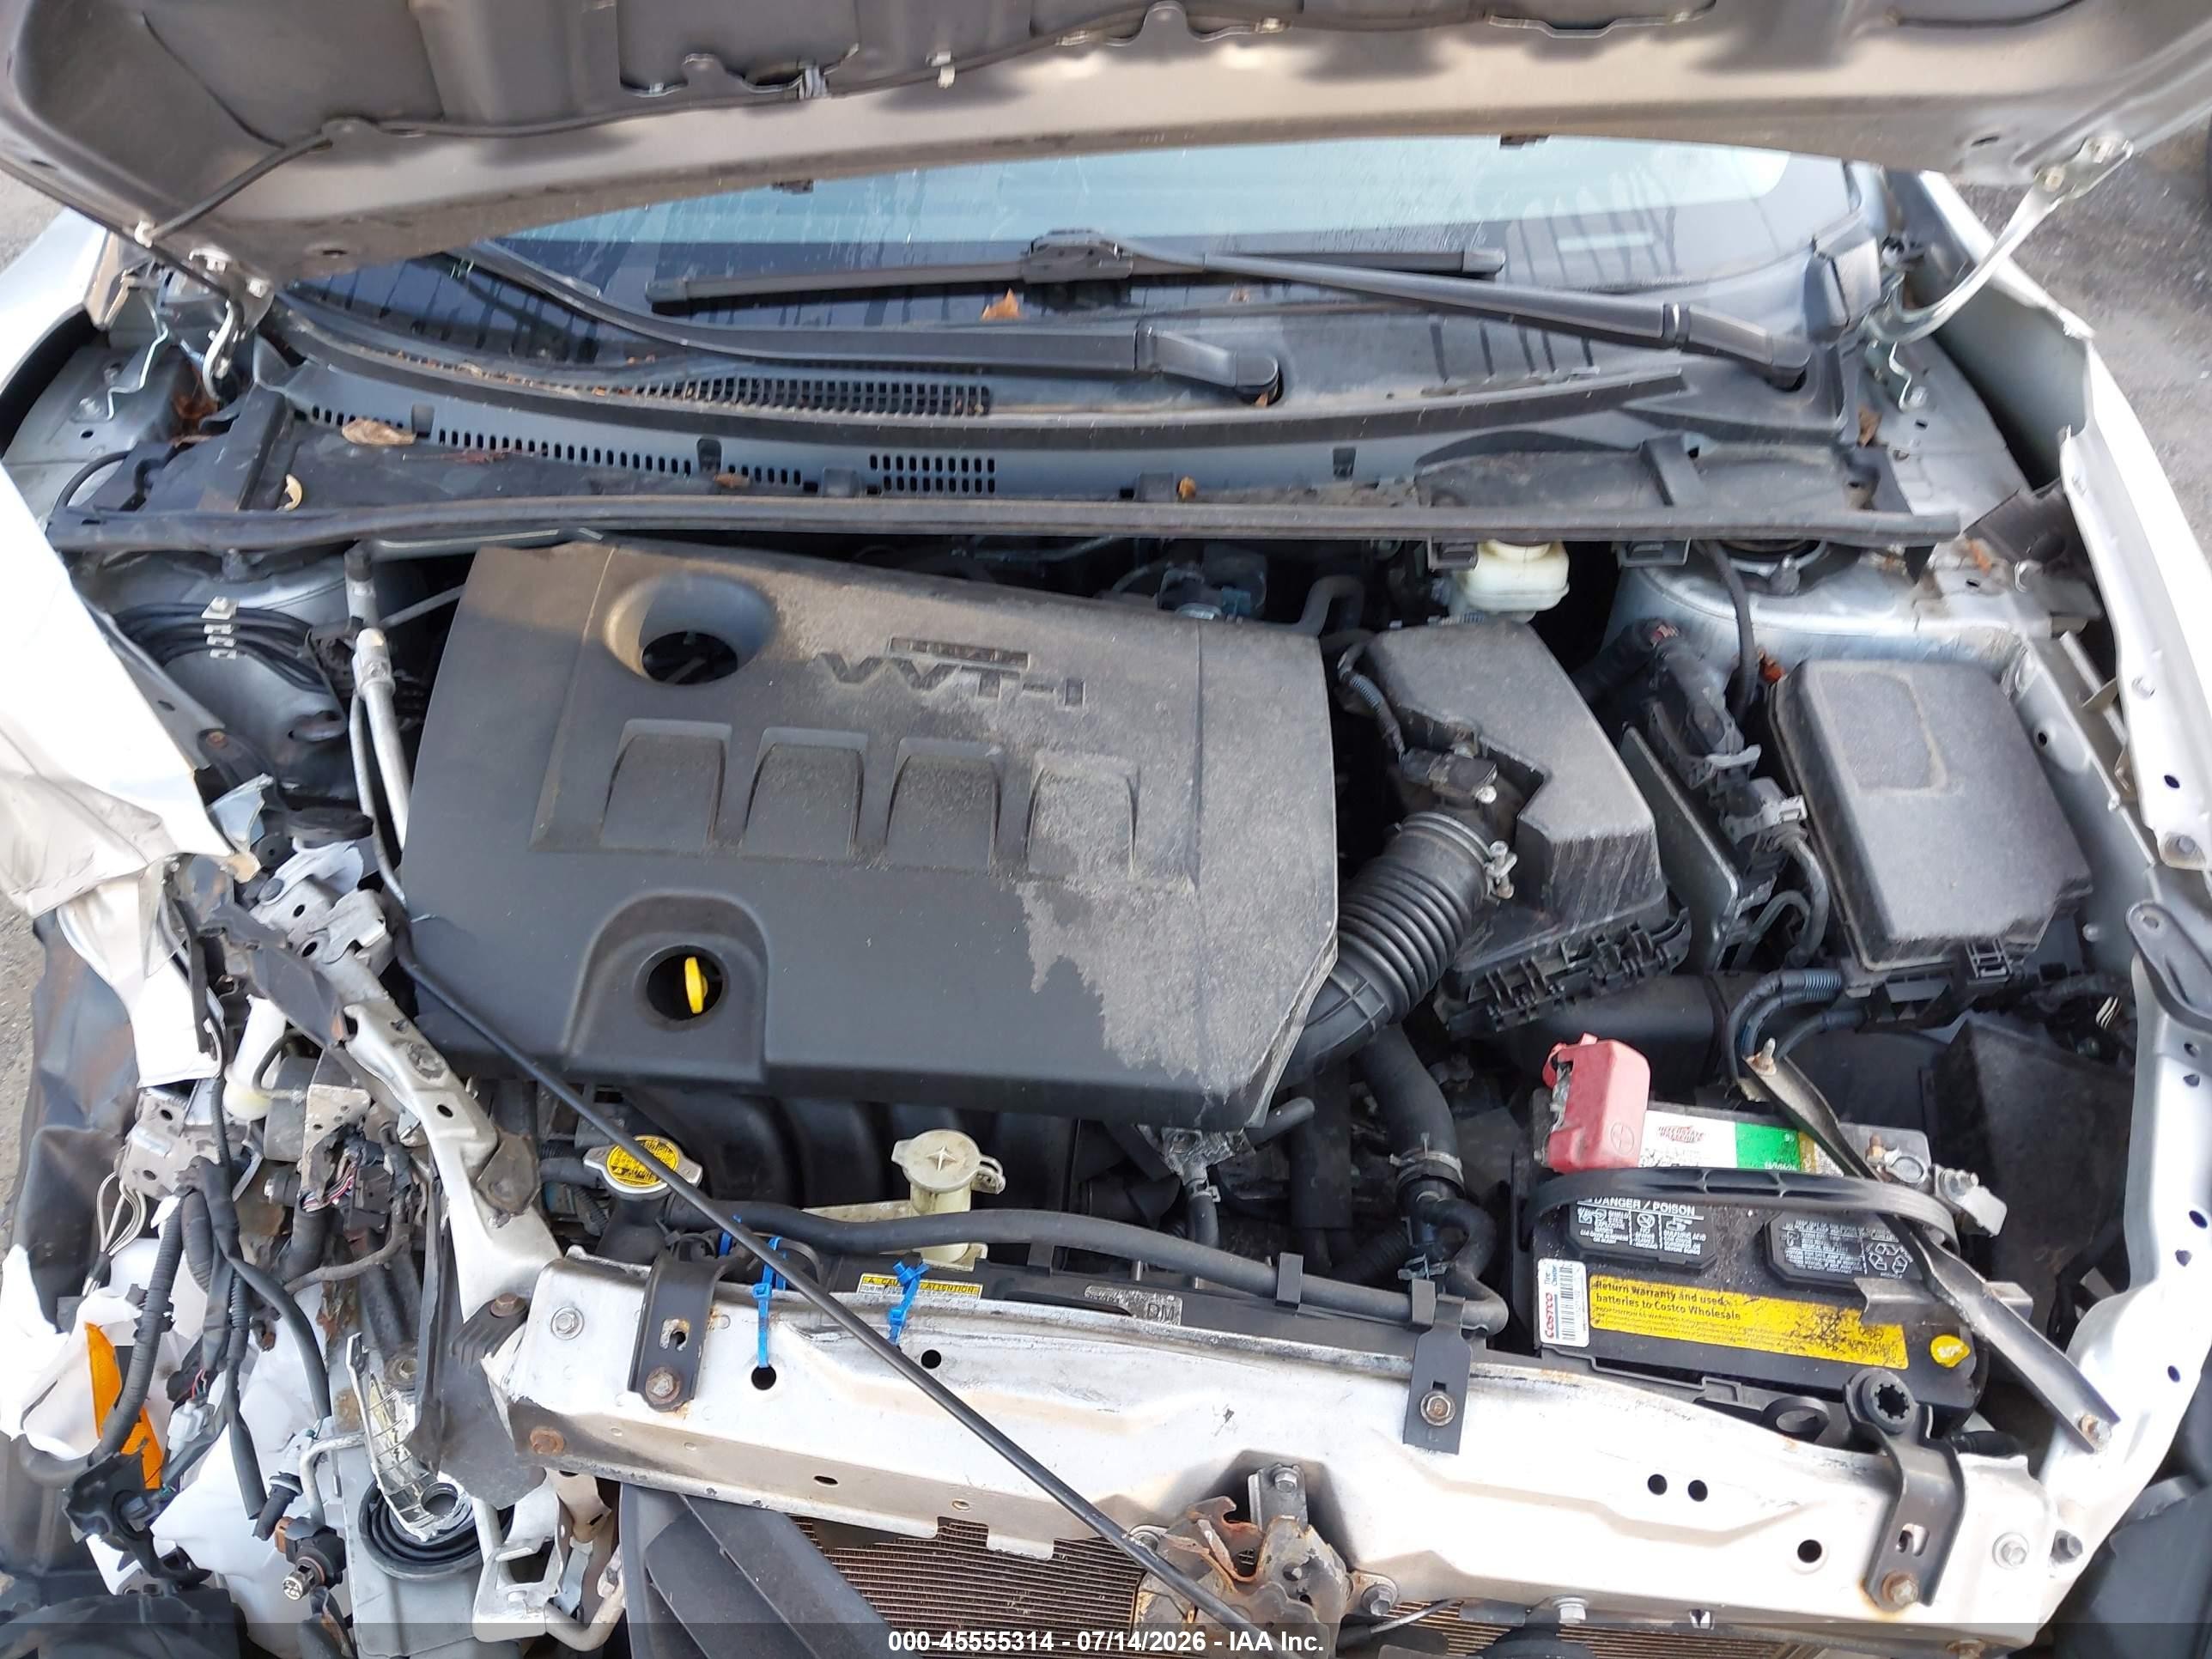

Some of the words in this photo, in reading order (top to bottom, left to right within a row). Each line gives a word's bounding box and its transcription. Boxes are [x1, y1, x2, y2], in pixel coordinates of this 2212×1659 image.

[1594, 1197, 1641, 1210] DANGER
[1652, 1200, 1695, 1216] POISON
[925, 1281, 977, 1294] ATTENTION
[1595, 1280, 1629, 1293] Return
[1632, 1286, 1675, 1301] warranty
[1679, 1291, 1697, 1302] and
[1595, 1293, 1639, 1308] batteries
[1642, 1299, 1652, 1309] to
[1654, 1301, 1686, 1314] Costco
[1688, 1305, 1741, 1321] Wholesale
